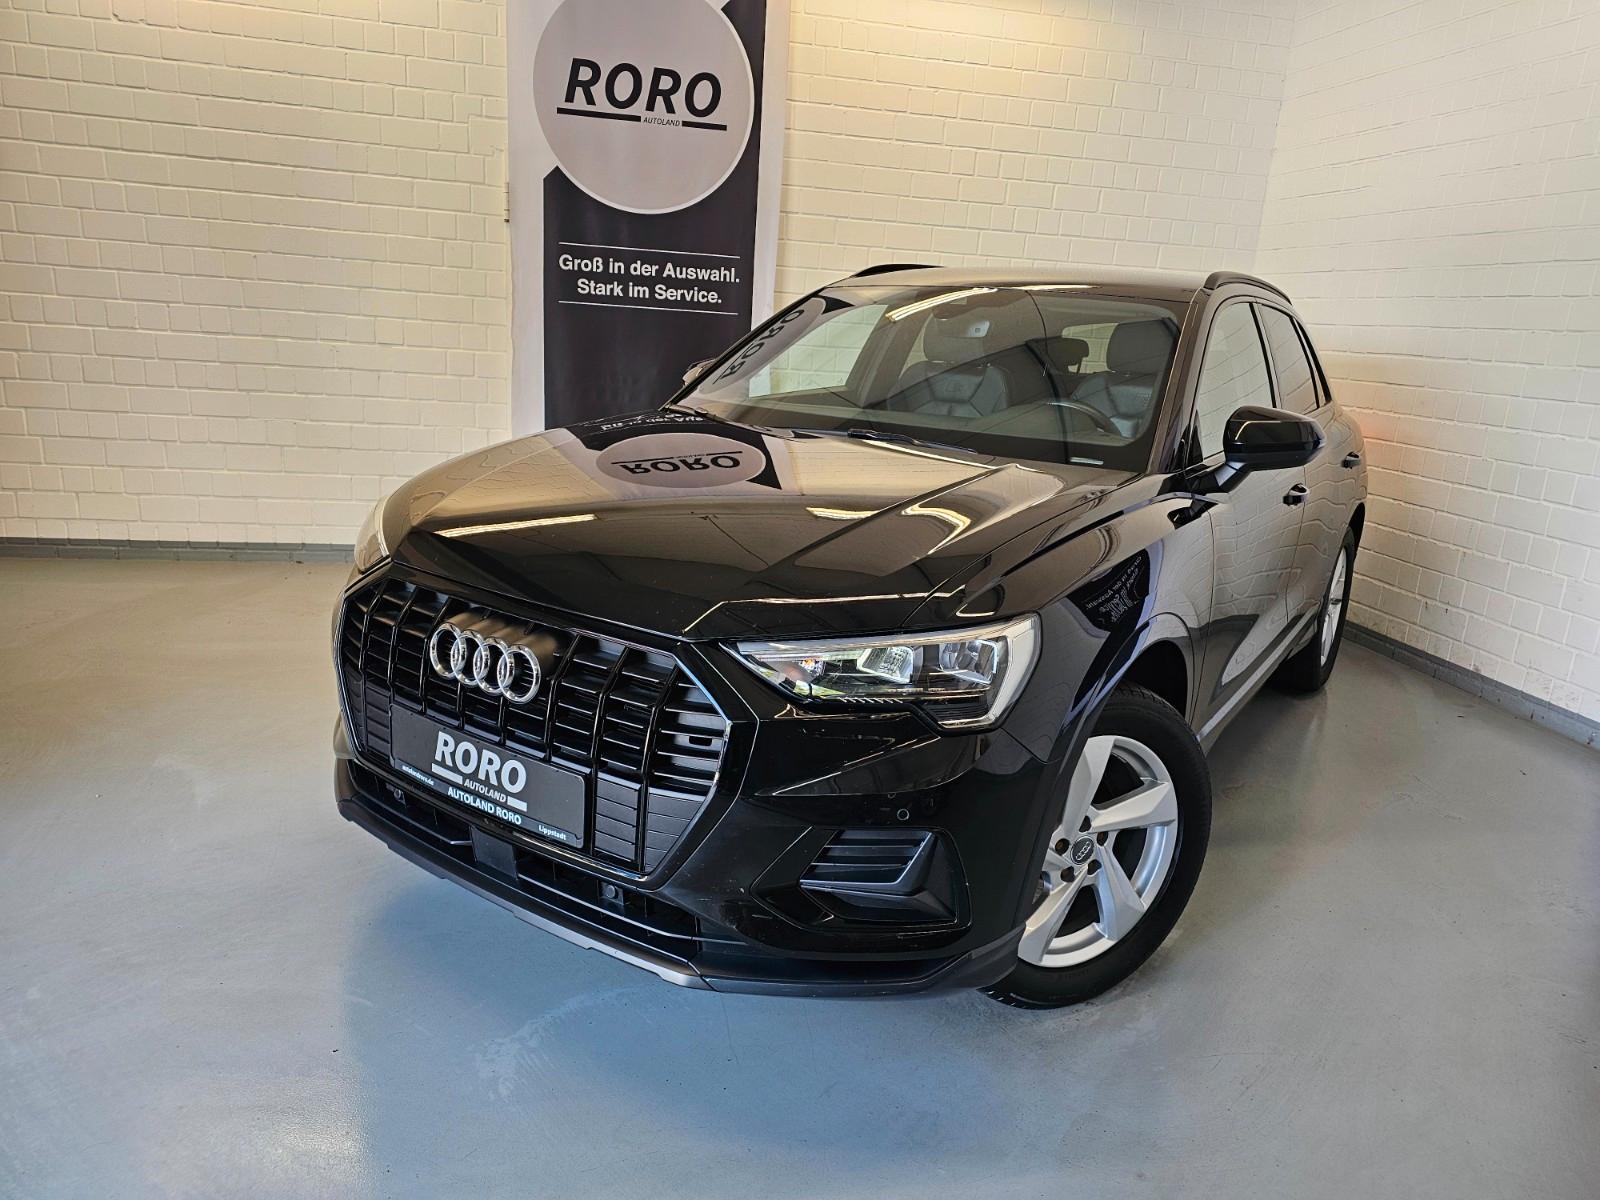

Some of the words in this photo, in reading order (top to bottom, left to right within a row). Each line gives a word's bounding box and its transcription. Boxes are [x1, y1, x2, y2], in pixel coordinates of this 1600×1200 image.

[564, 58, 722, 118] RORO
[643, 117, 681, 127] AUTOLAND
[558, 254, 603, 273] Groß
[609, 258, 625, 274] in
[630, 260, 659, 277] der
[662, 262, 740, 283] Auswahl.
[577, 278, 624, 297] Stark
[628, 282, 650, 299] im
[654, 284, 722, 304] Service.
[434, 731, 527, 794] RORO
[464, 778, 506, 803] AUTOLAND
[447, 786, 495, 814] AUTOLAND
[495, 806, 522, 825] RORO
[538, 824, 567, 841] Lippstadt
